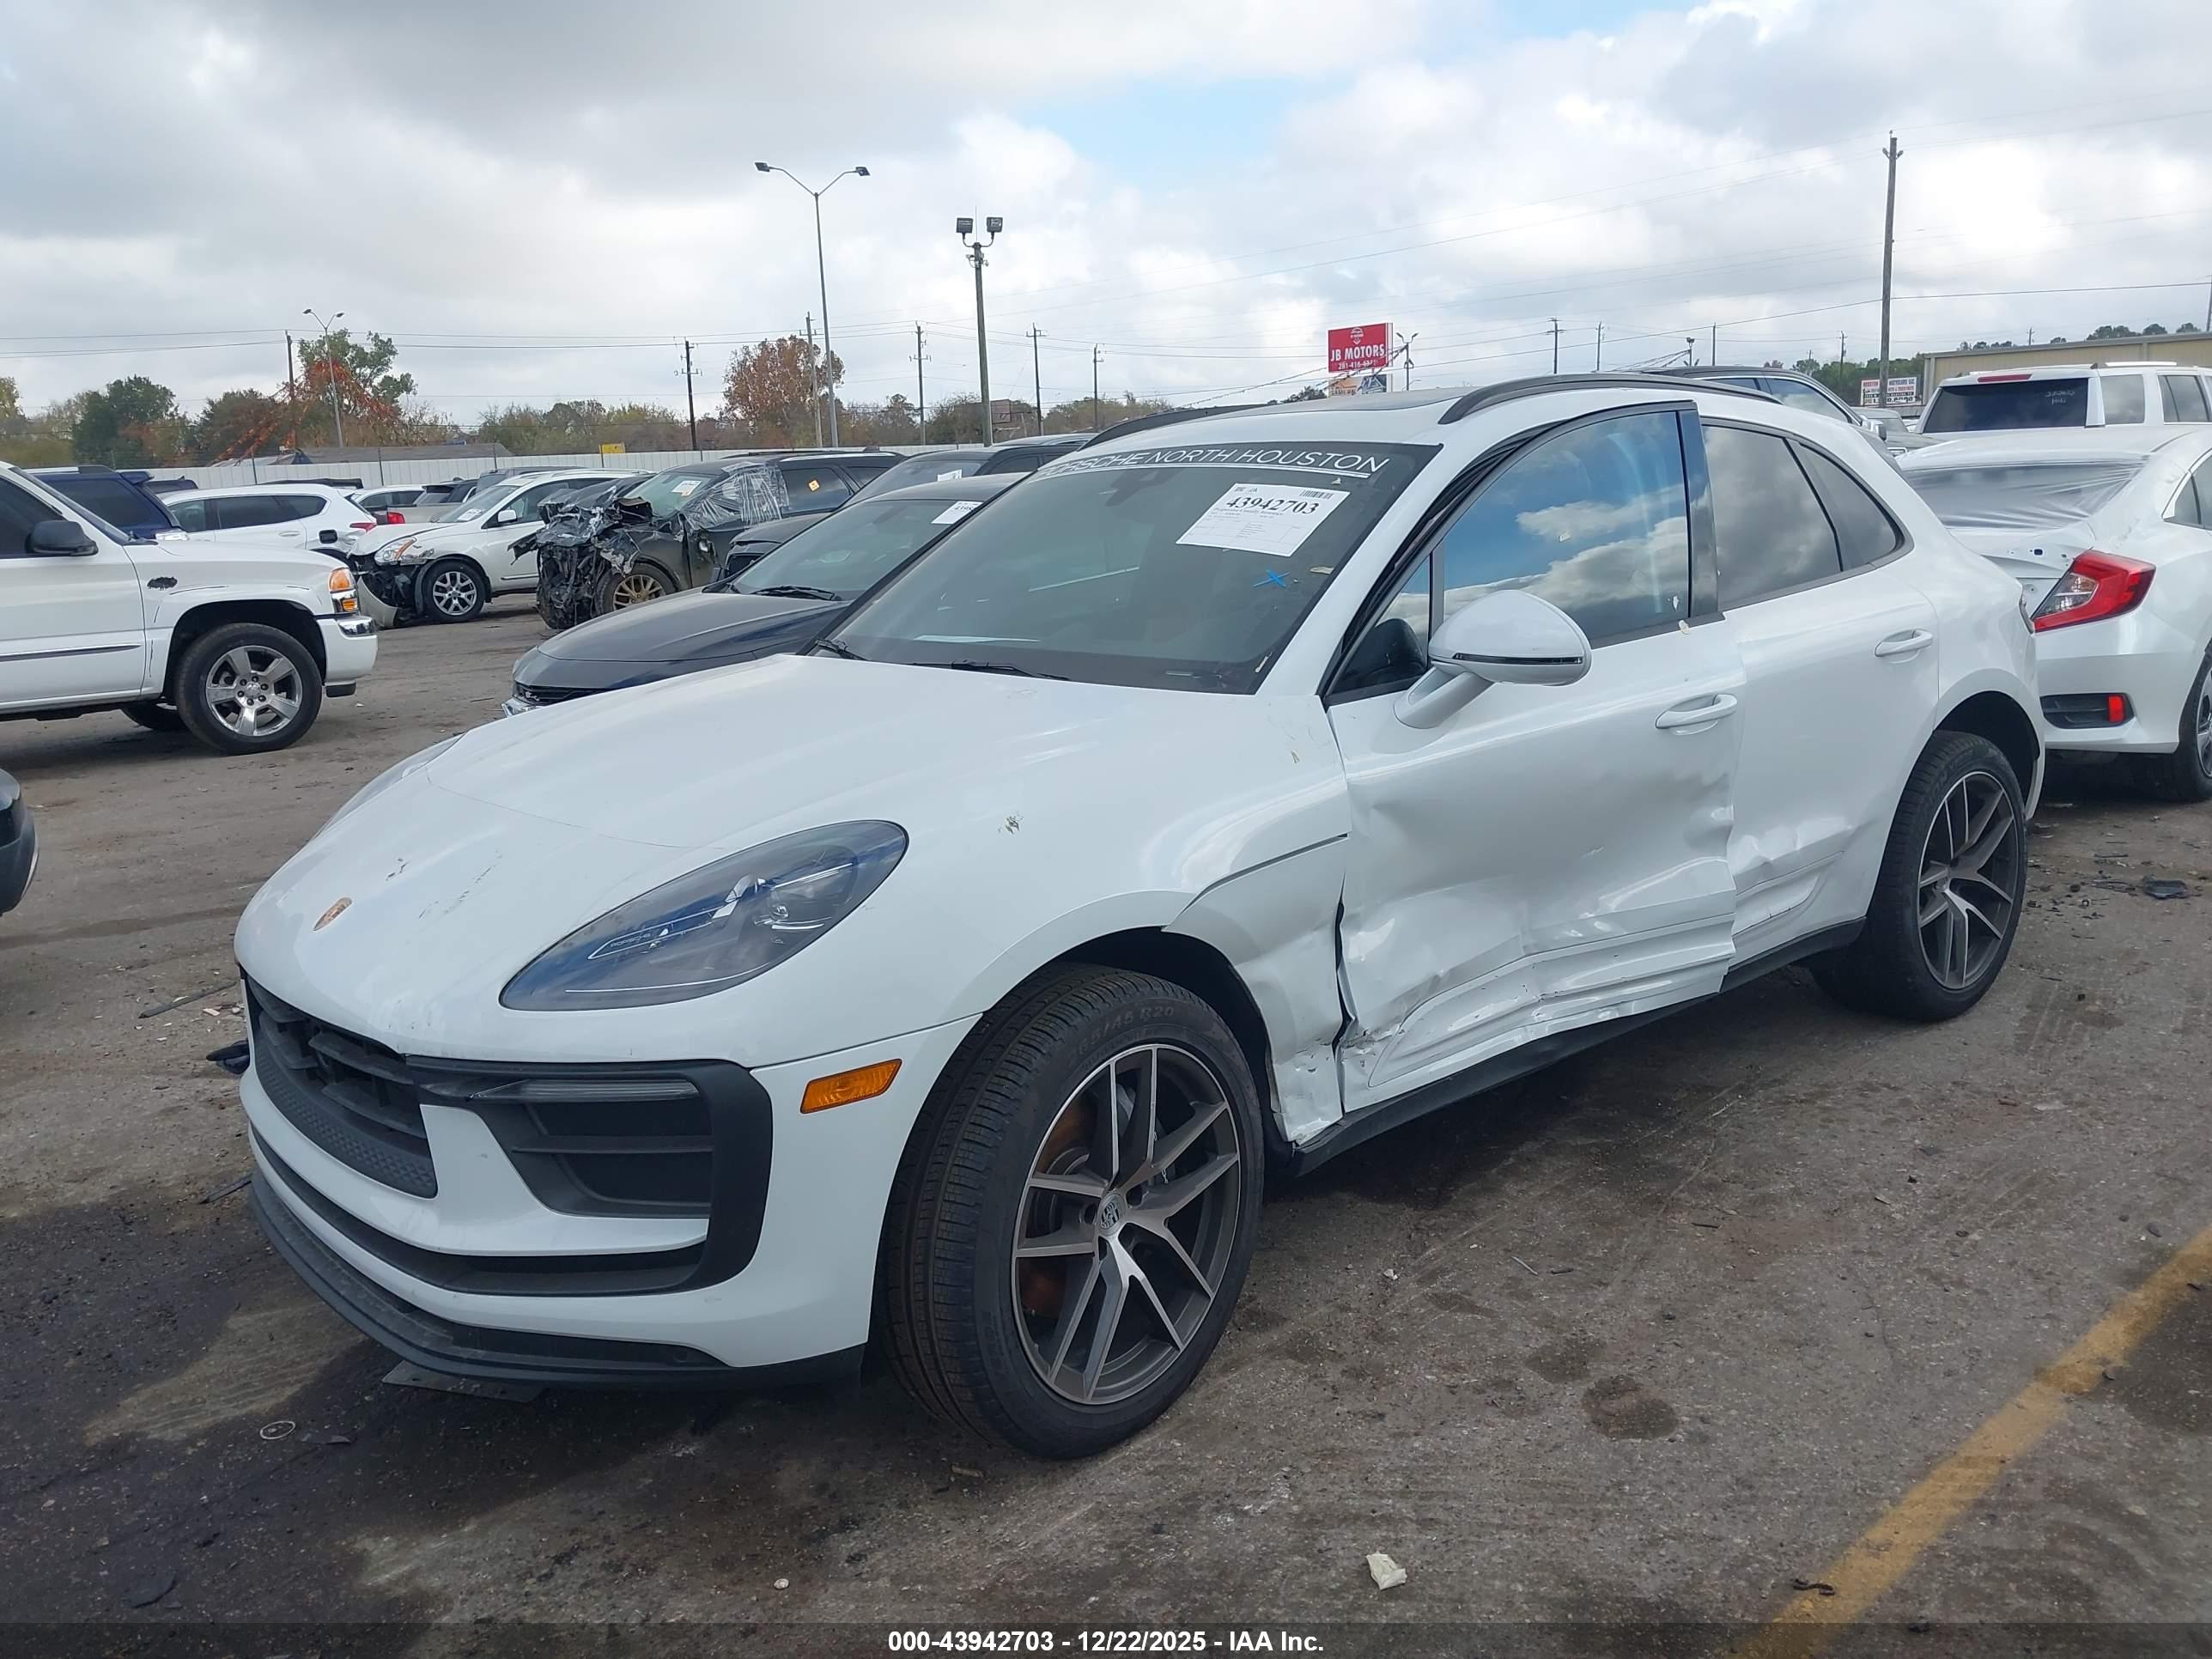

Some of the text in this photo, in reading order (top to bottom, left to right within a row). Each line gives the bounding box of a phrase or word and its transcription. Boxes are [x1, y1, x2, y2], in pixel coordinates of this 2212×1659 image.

[1330, 343, 1385, 362] JB MOTORS
[1145, 448, 1238, 464] NORTH
[1235, 448, 1391, 473] HOUSTON
[1226, 496, 1320, 515] 43942703
